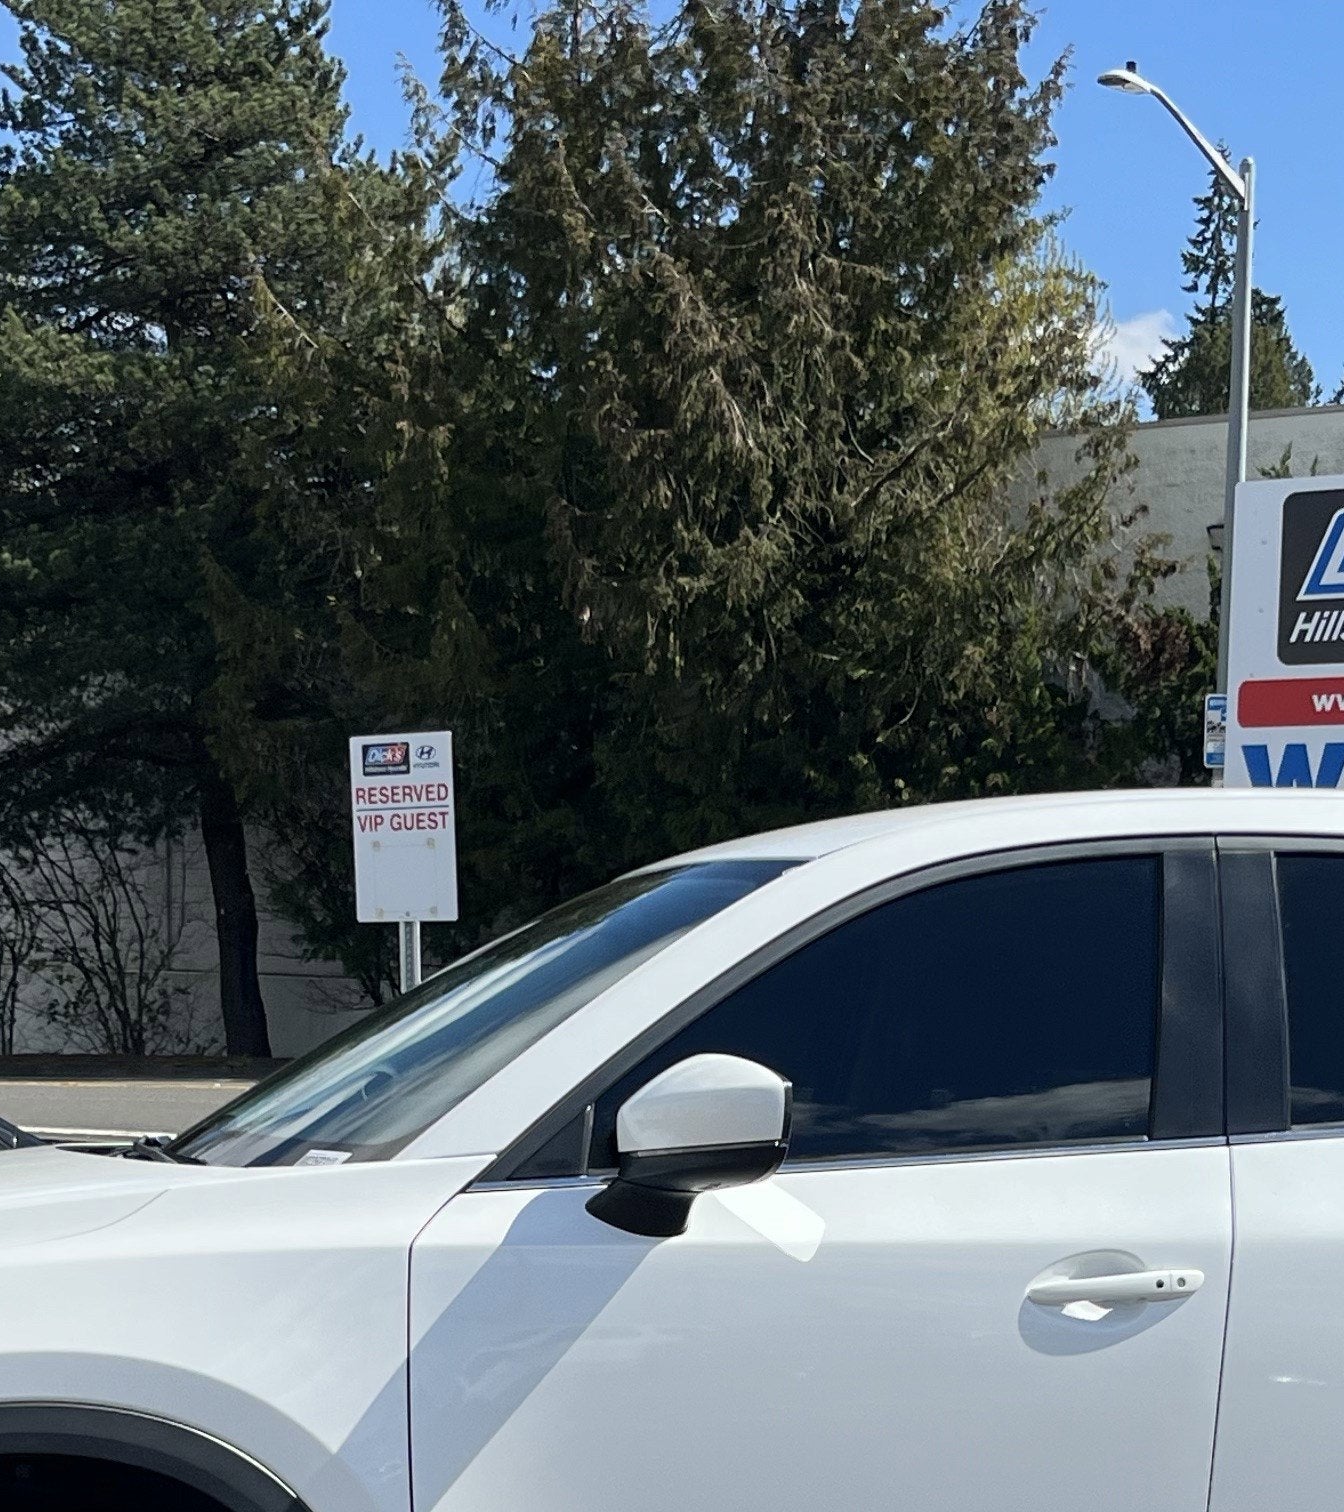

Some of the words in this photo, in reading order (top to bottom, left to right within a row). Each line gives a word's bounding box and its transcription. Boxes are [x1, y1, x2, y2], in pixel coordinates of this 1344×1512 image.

[356, 784, 449, 806] RESERVED
[357, 814, 384, 833] VIP
[390, 812, 449, 832] GUEST
